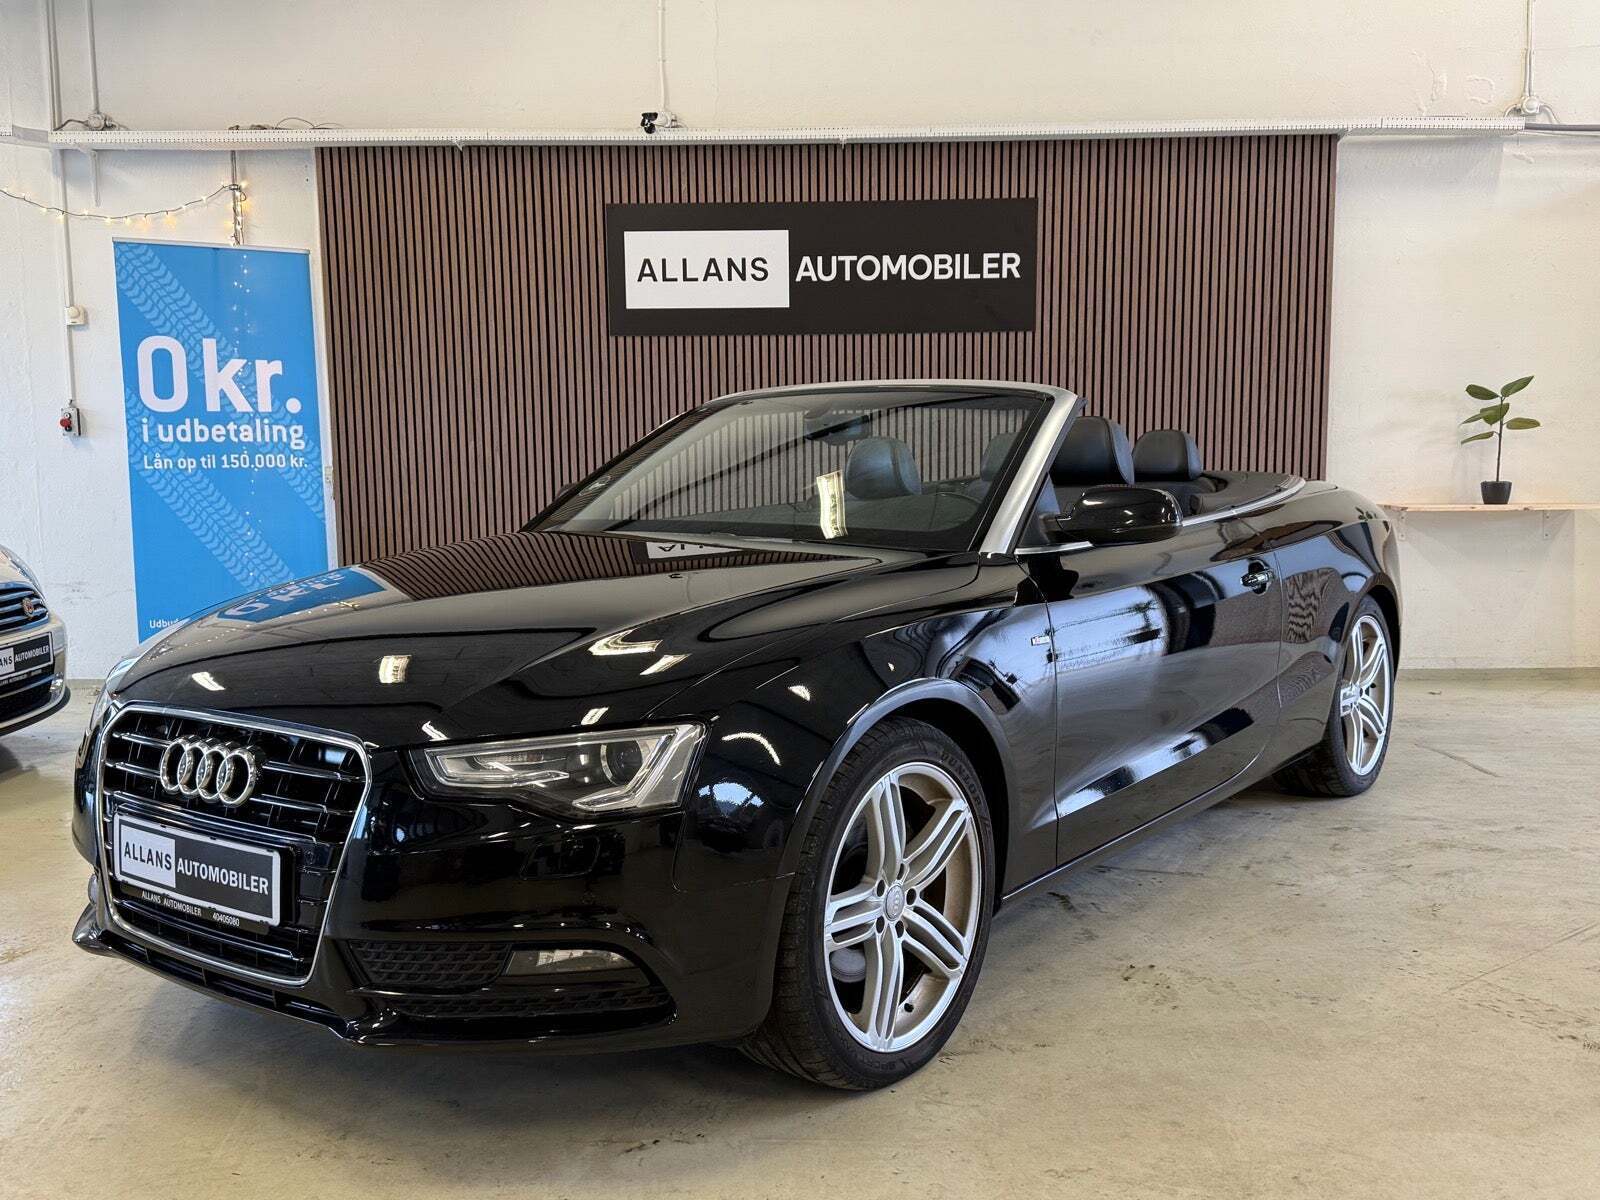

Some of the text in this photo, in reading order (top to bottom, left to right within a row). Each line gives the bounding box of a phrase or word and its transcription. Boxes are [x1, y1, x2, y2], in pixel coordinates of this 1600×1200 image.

[636, 252, 1022, 283] ALLANS AUTOMOBILER
[137, 335, 302, 414] 0 kr.
[142, 417, 305, 450] i udbetaling
[143, 452, 308, 474] Lån op til 150.000 kr.
[14, 644, 50, 663] AUTOMOBILER
[123, 841, 269, 895] ALLANS AUTOMOBILER
[141, 890, 161, 904] ALLANS
[163, 898, 202, 917] AUTOMOBILER
